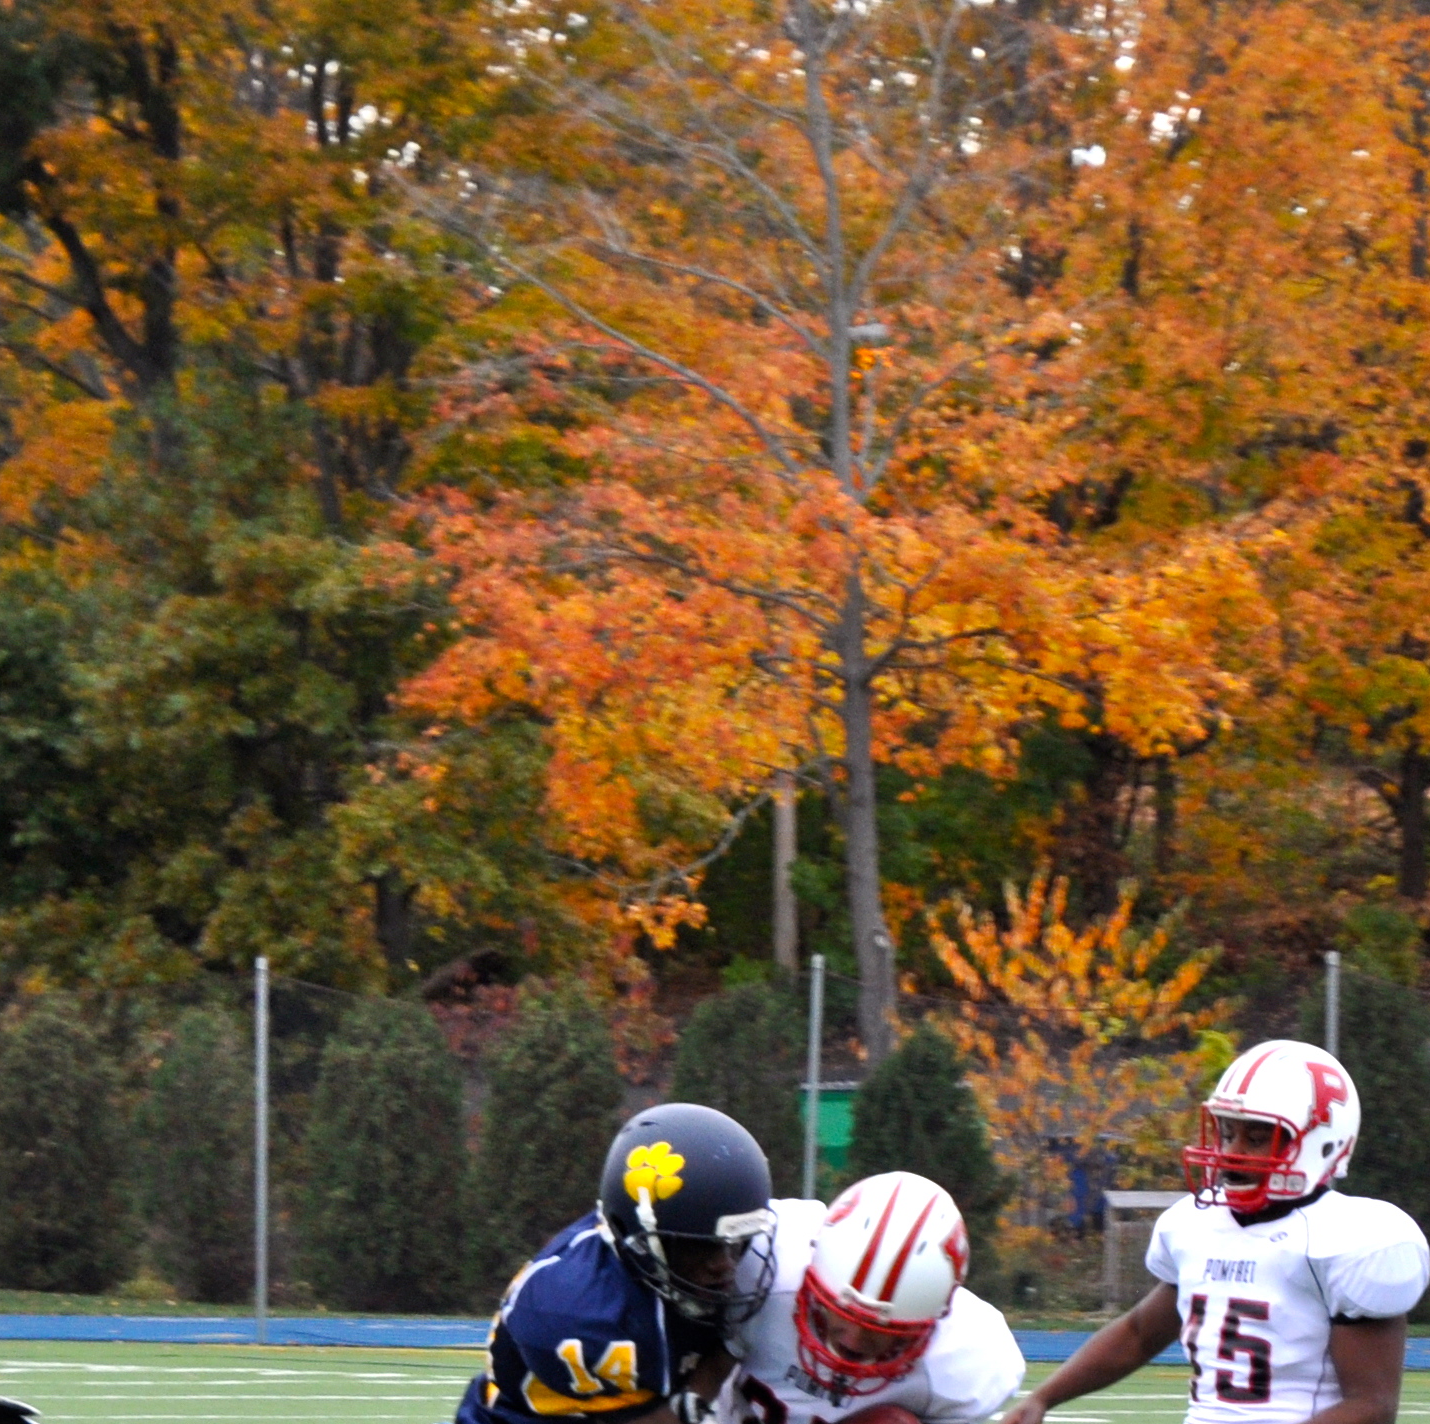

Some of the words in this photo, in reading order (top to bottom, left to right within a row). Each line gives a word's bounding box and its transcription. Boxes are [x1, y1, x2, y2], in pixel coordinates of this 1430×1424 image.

[1304, 1061, 1348, 1127] P
[1202, 1258, 1257, 1284] POMFRET
[555, 1338, 637, 1393] 14
[1187, 1293, 1272, 1404] 15
